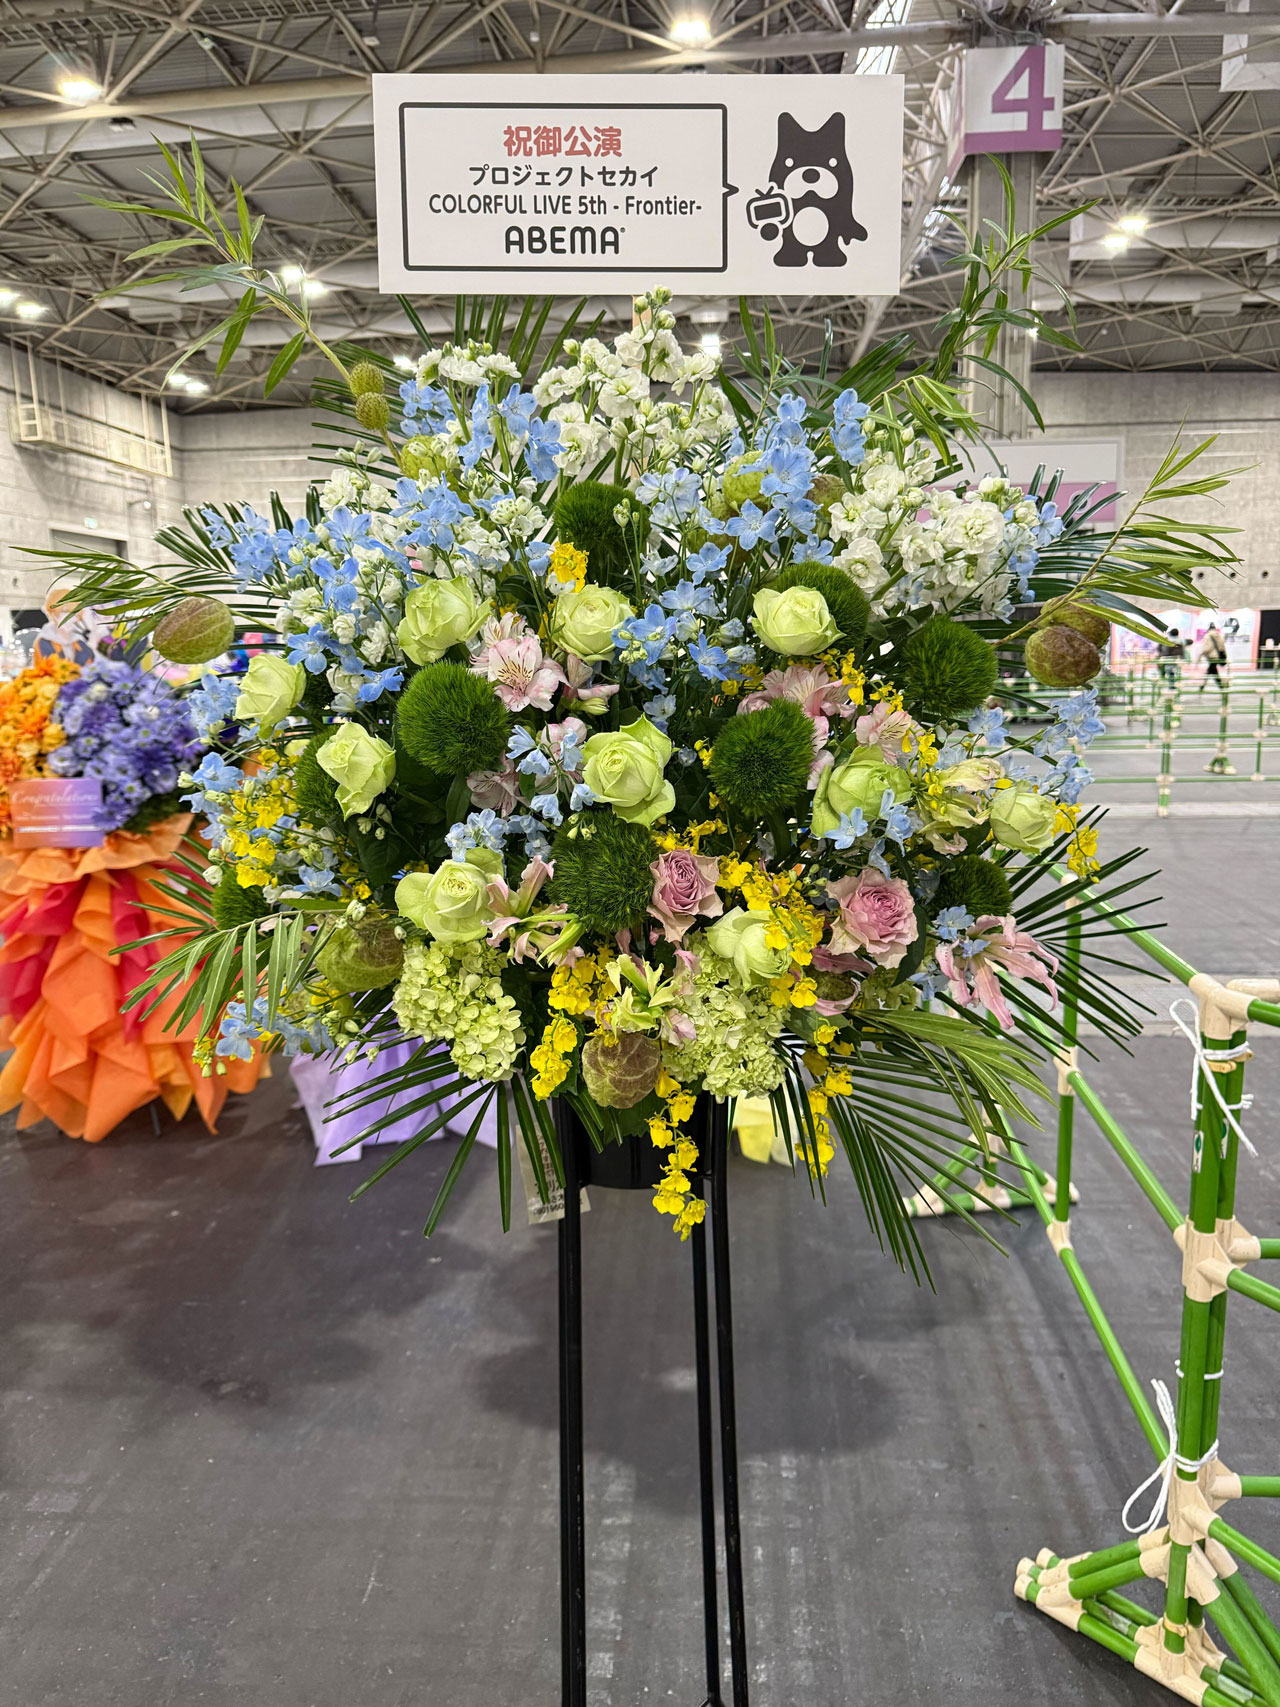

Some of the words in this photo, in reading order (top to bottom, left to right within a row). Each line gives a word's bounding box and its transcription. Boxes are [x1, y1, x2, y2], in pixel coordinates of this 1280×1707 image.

[991, 45, 1055, 132] 4
[503, 125, 623, 158] 祝御公演
[468, 164, 659, 188] プロジェクトセカイ
[428, 194, 527, 215] COLORFUL
[533, 194, 571, 215] LIVE
[577, 194, 606, 216] 5th
[625, 194, 702, 216] Frontier-
[504, 225, 620, 255] ABEMA
